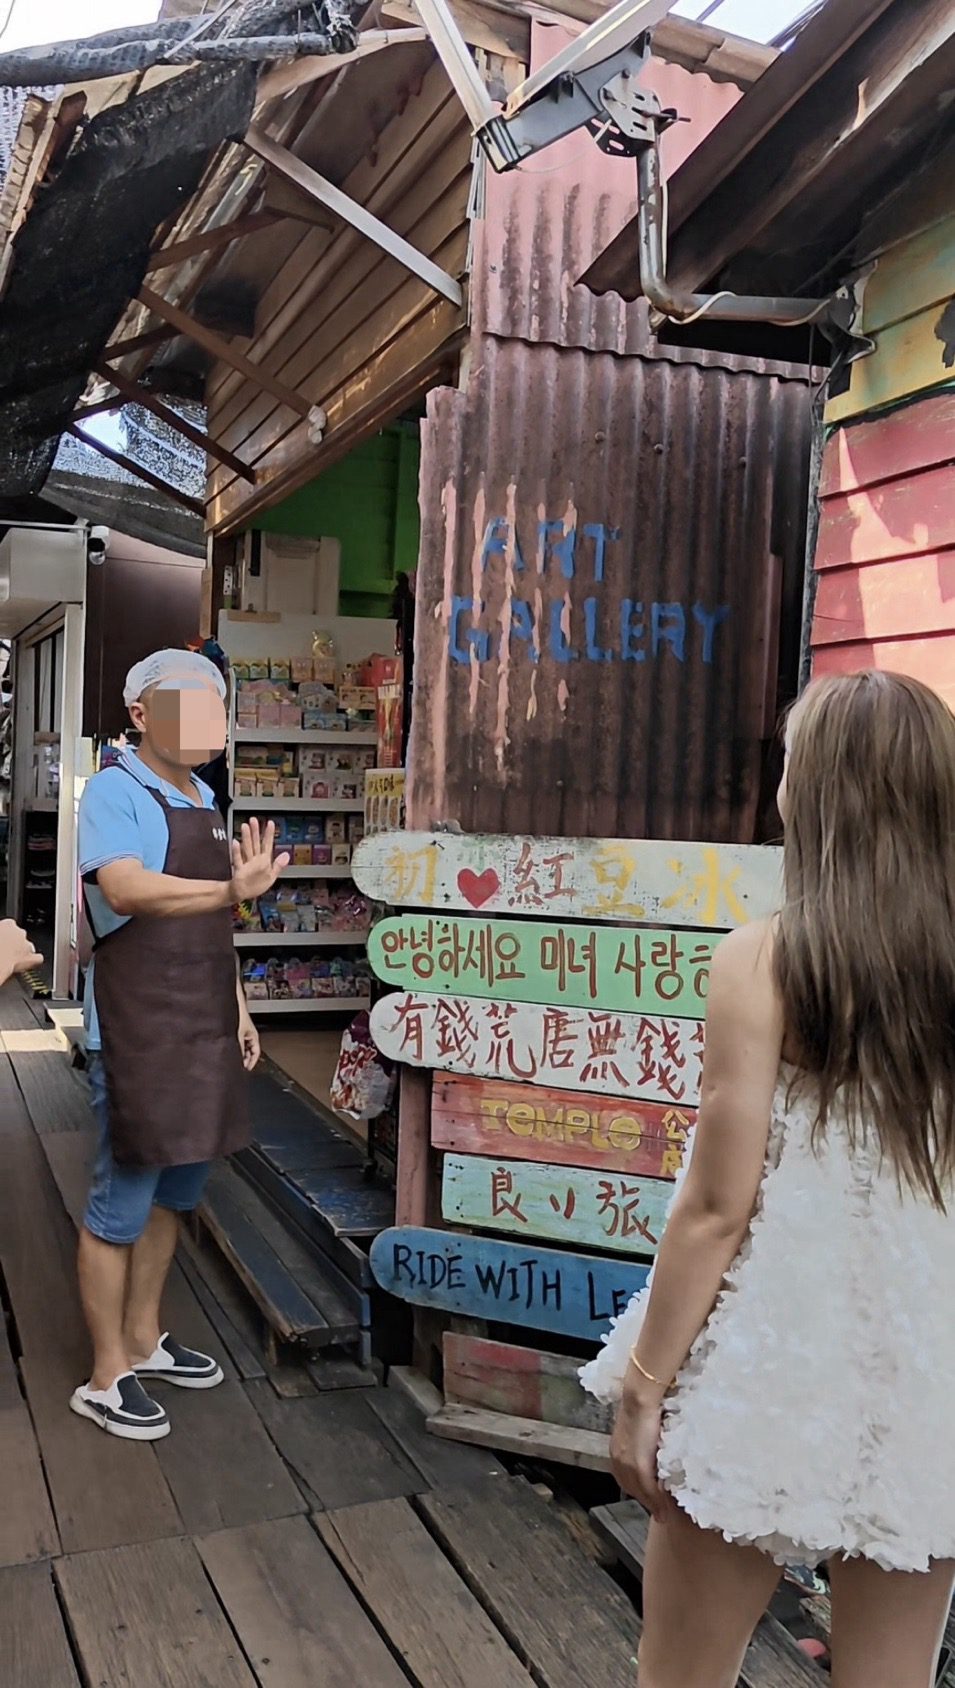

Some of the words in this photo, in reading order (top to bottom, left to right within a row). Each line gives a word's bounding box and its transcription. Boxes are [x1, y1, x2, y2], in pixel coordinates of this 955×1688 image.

[481, 515, 621, 582] ART
[449, 595, 730, 664] GALLERY
[508, 842, 749, 923] 紅豆冰
[381, 919, 526, 988] 안녕하세요
[540, 928, 598, 999] 미녀
[388, 992, 705, 1101] 有錢荒唐無錢
[393, 1243, 466, 1290] RIDE
[474, 1260, 562, 1312] WITH
